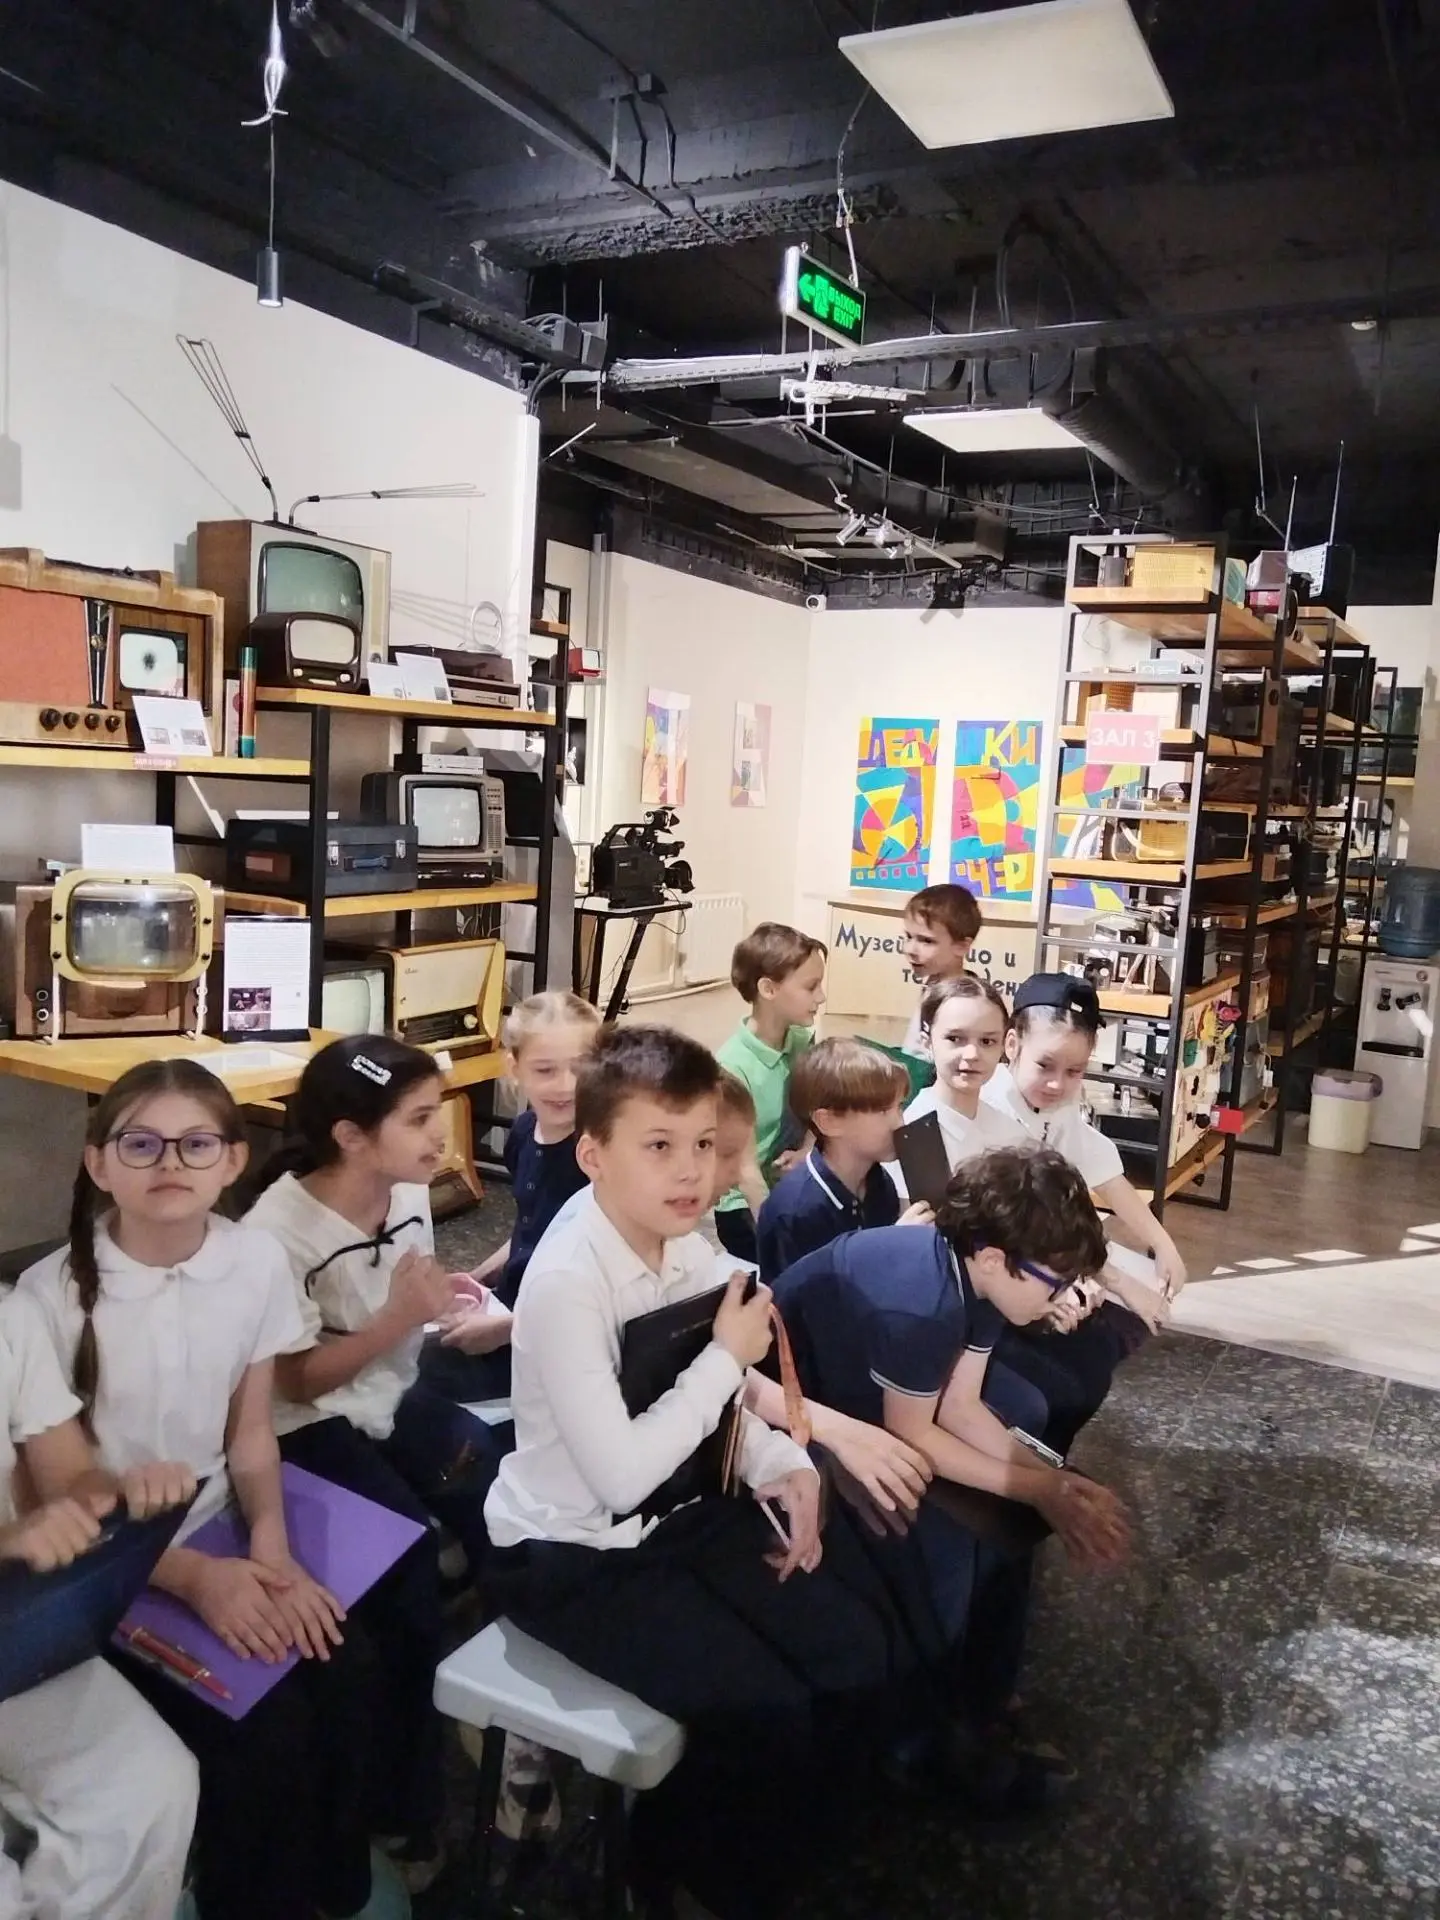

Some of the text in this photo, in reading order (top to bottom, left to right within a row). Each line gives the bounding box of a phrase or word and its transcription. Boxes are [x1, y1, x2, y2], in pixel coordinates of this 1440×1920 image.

[833, 306, 854, 330] EXIT
[1090, 728, 1154, 748] ЗАЛ 3
[835, 922, 905, 958] Музей
[1004, 952, 1016, 967] и
